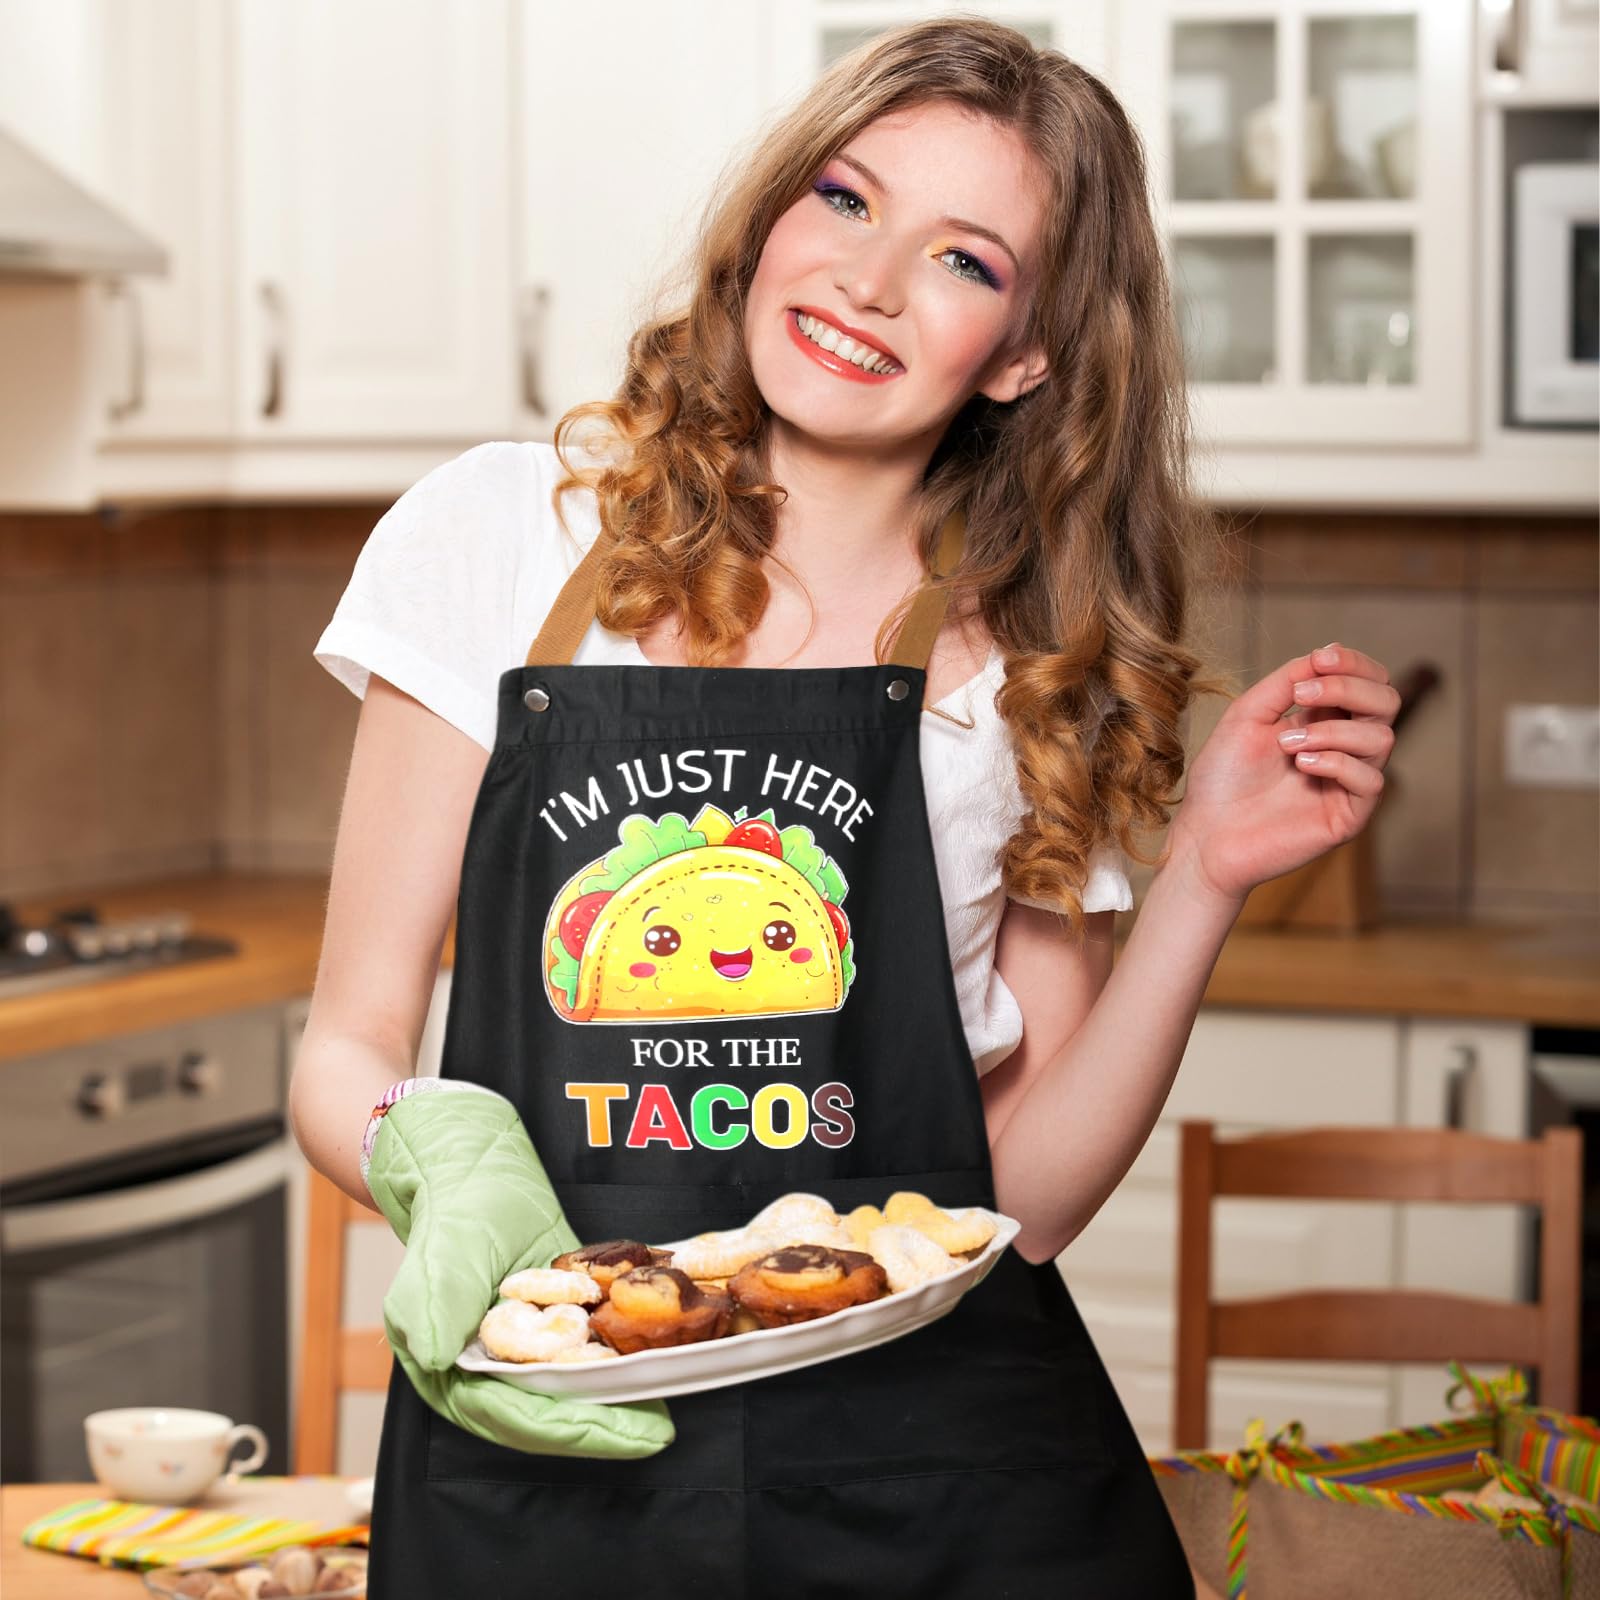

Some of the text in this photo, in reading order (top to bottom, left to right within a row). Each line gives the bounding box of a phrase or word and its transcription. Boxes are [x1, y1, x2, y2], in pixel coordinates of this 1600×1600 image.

[539, 749, 874, 842] I'M JUST HERE
[630, 1037, 801, 1068] FOR THE
[565, 1081, 855, 1150] TACOS
